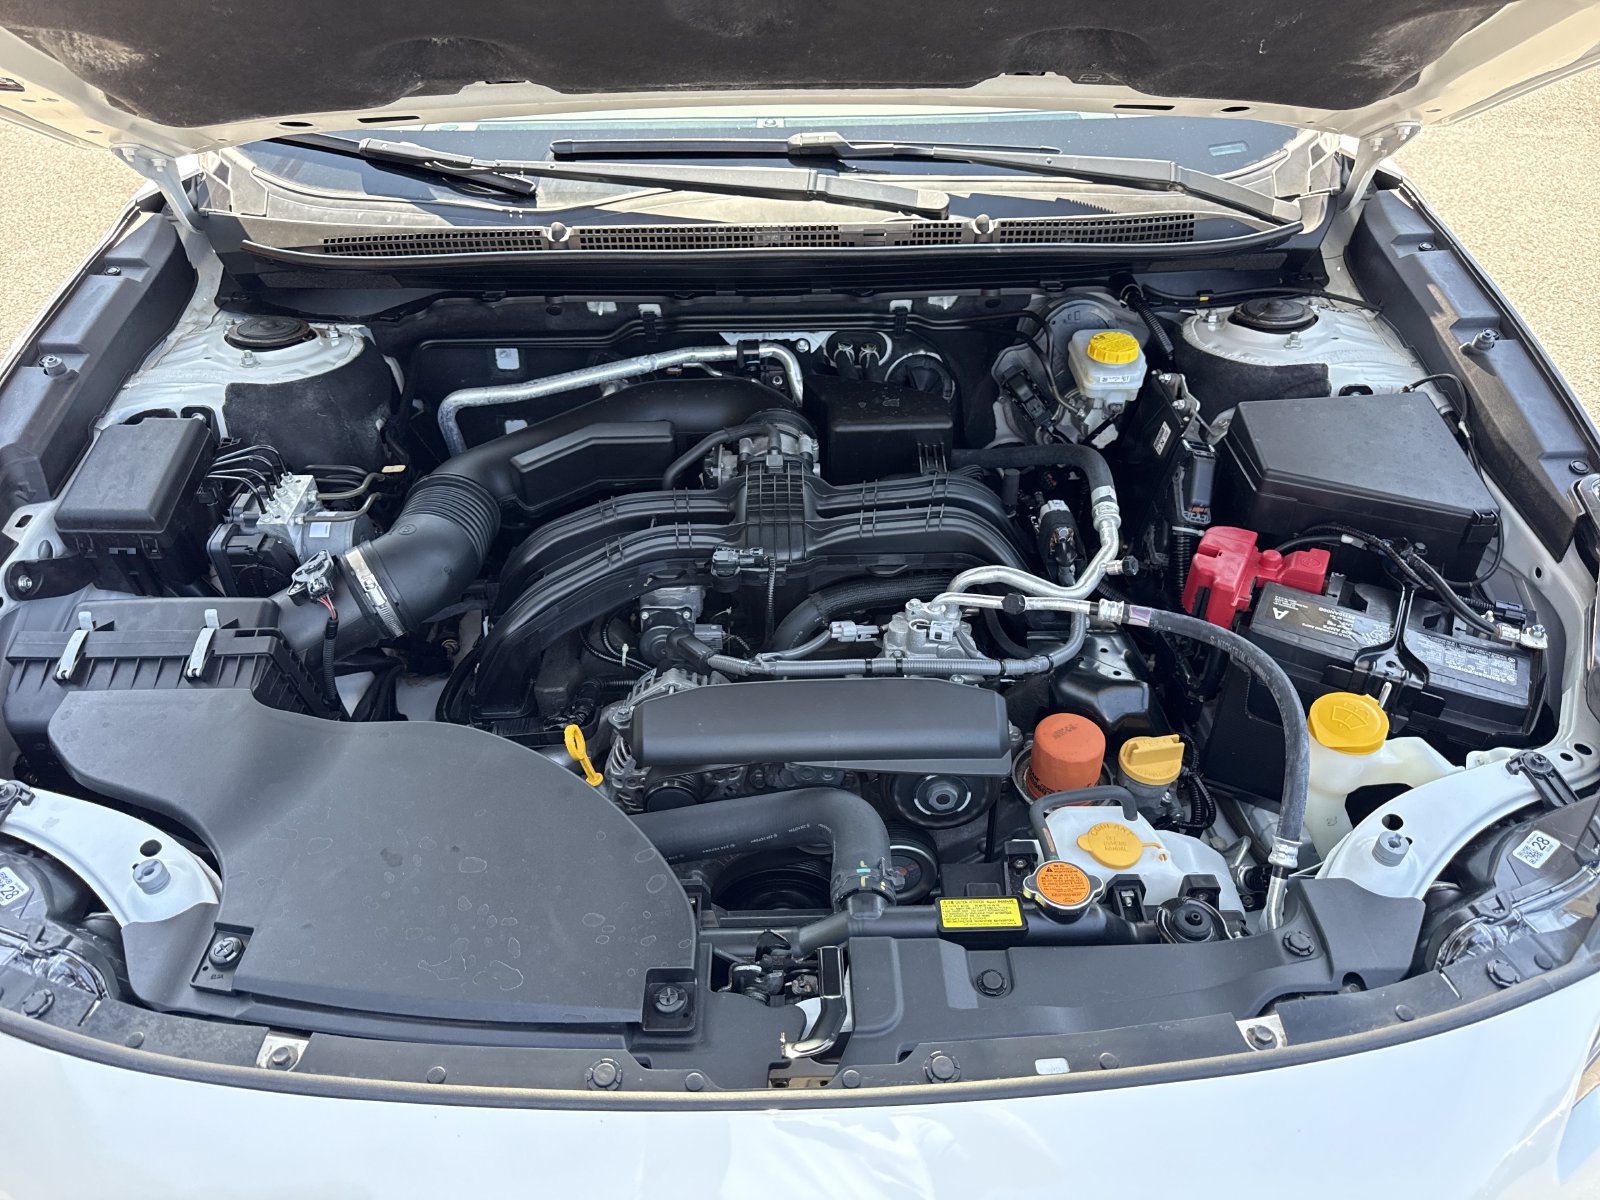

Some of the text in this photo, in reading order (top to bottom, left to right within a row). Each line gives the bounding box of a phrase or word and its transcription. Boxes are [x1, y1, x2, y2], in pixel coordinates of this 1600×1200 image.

[1272, 607, 1289, 620] A
[1531, 836, 1550, 851] 28
[0, 885, 19, 900] 28
